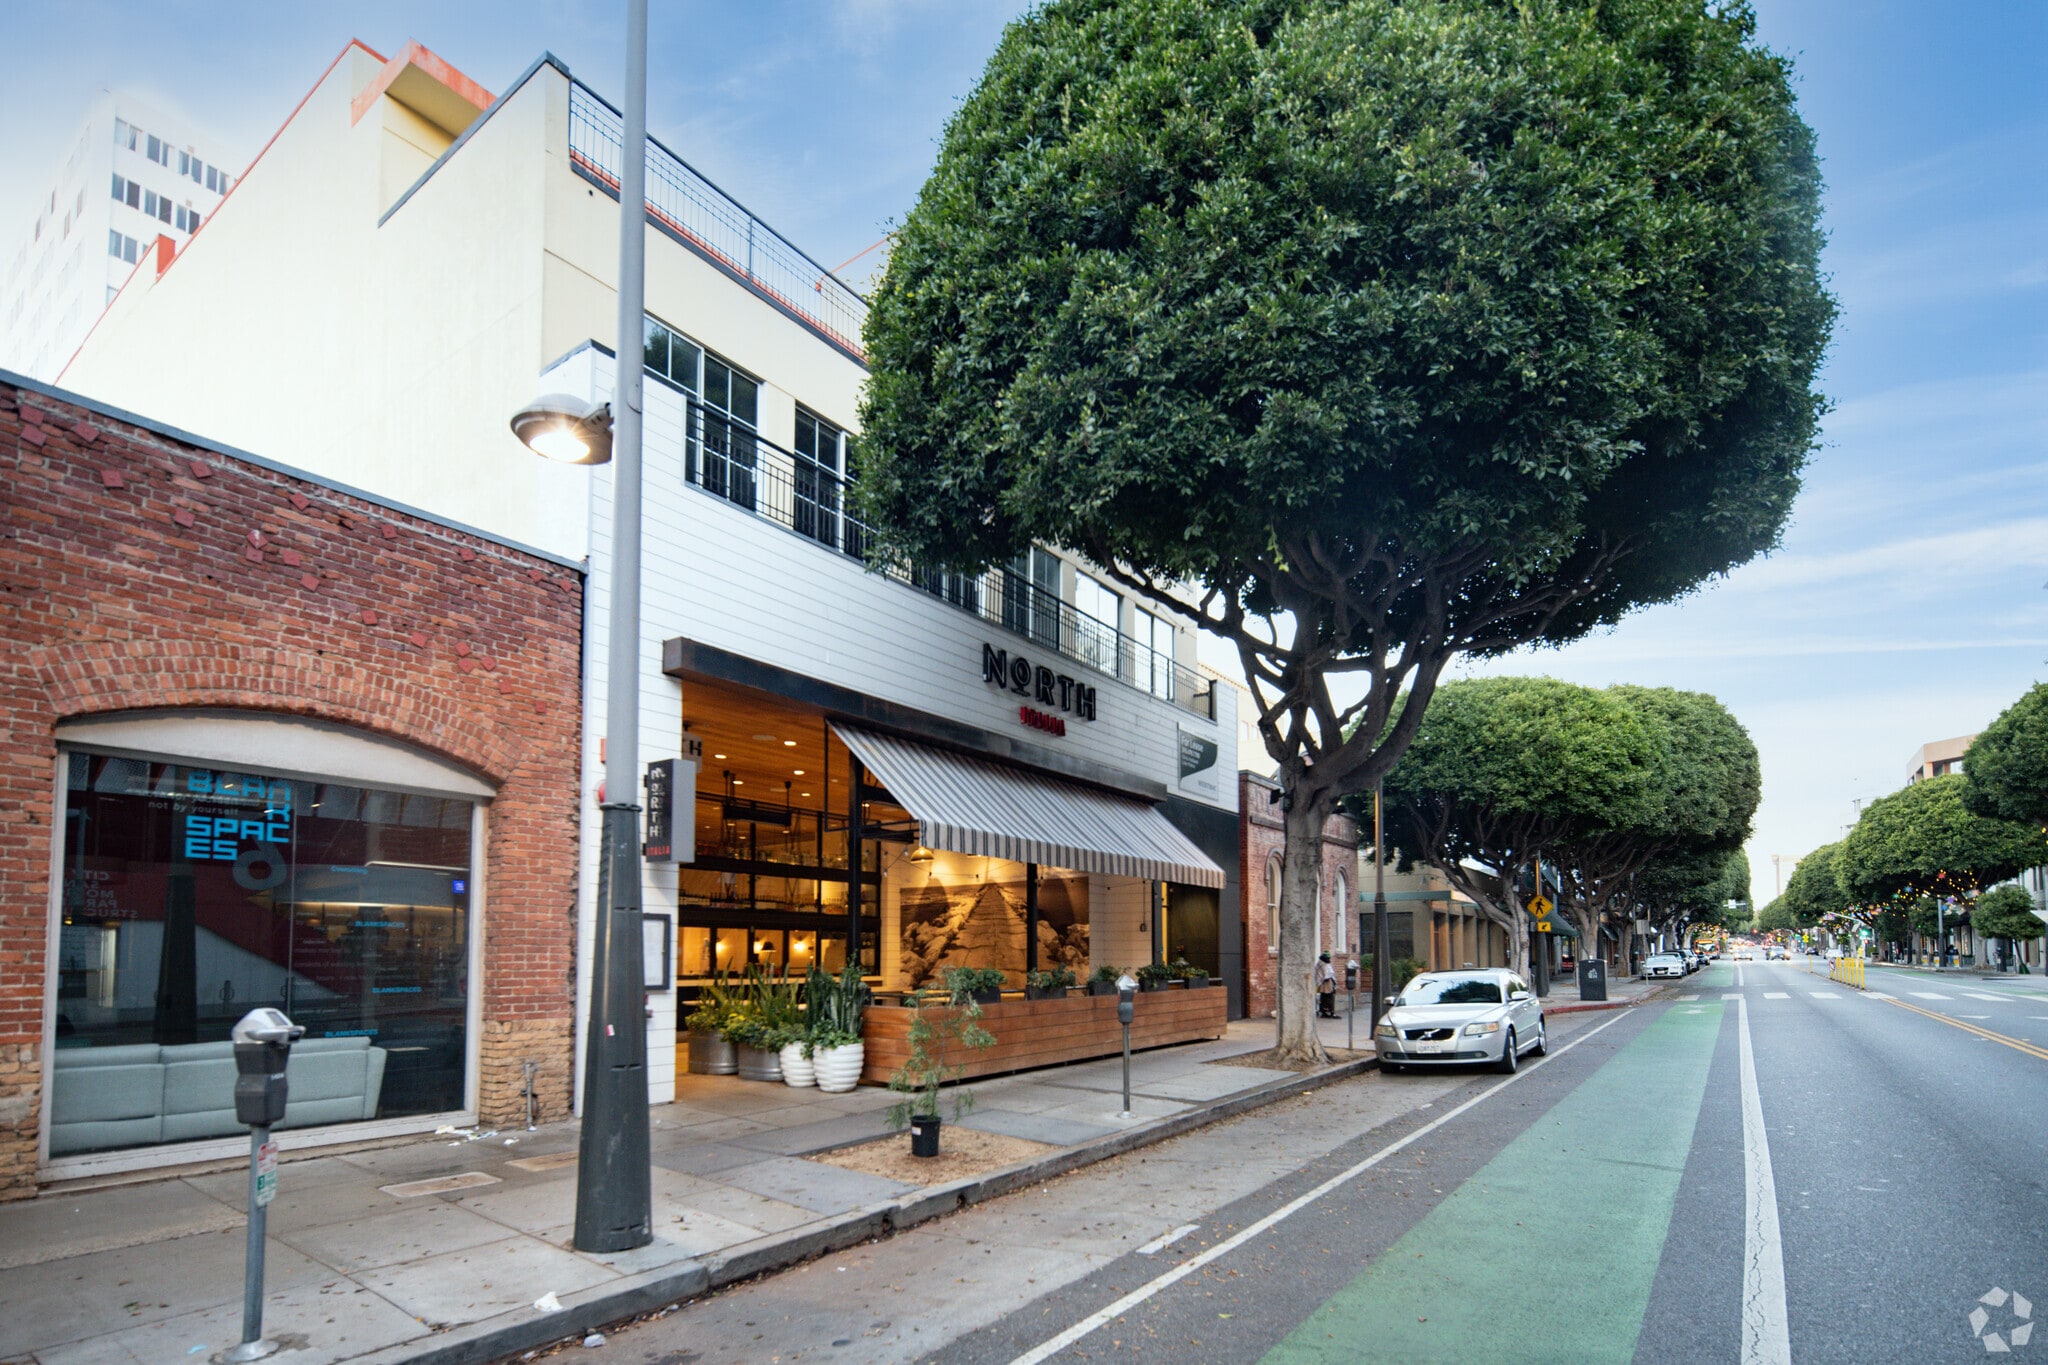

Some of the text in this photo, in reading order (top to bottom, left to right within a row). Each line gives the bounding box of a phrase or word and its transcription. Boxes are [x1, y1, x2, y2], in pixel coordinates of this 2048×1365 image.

[982, 643, 1097, 721] NORTH
[148, 800, 240, 816] not by yourself
[650, 767, 667, 838] NORTH
[646, 845, 670, 857] ITALIA
